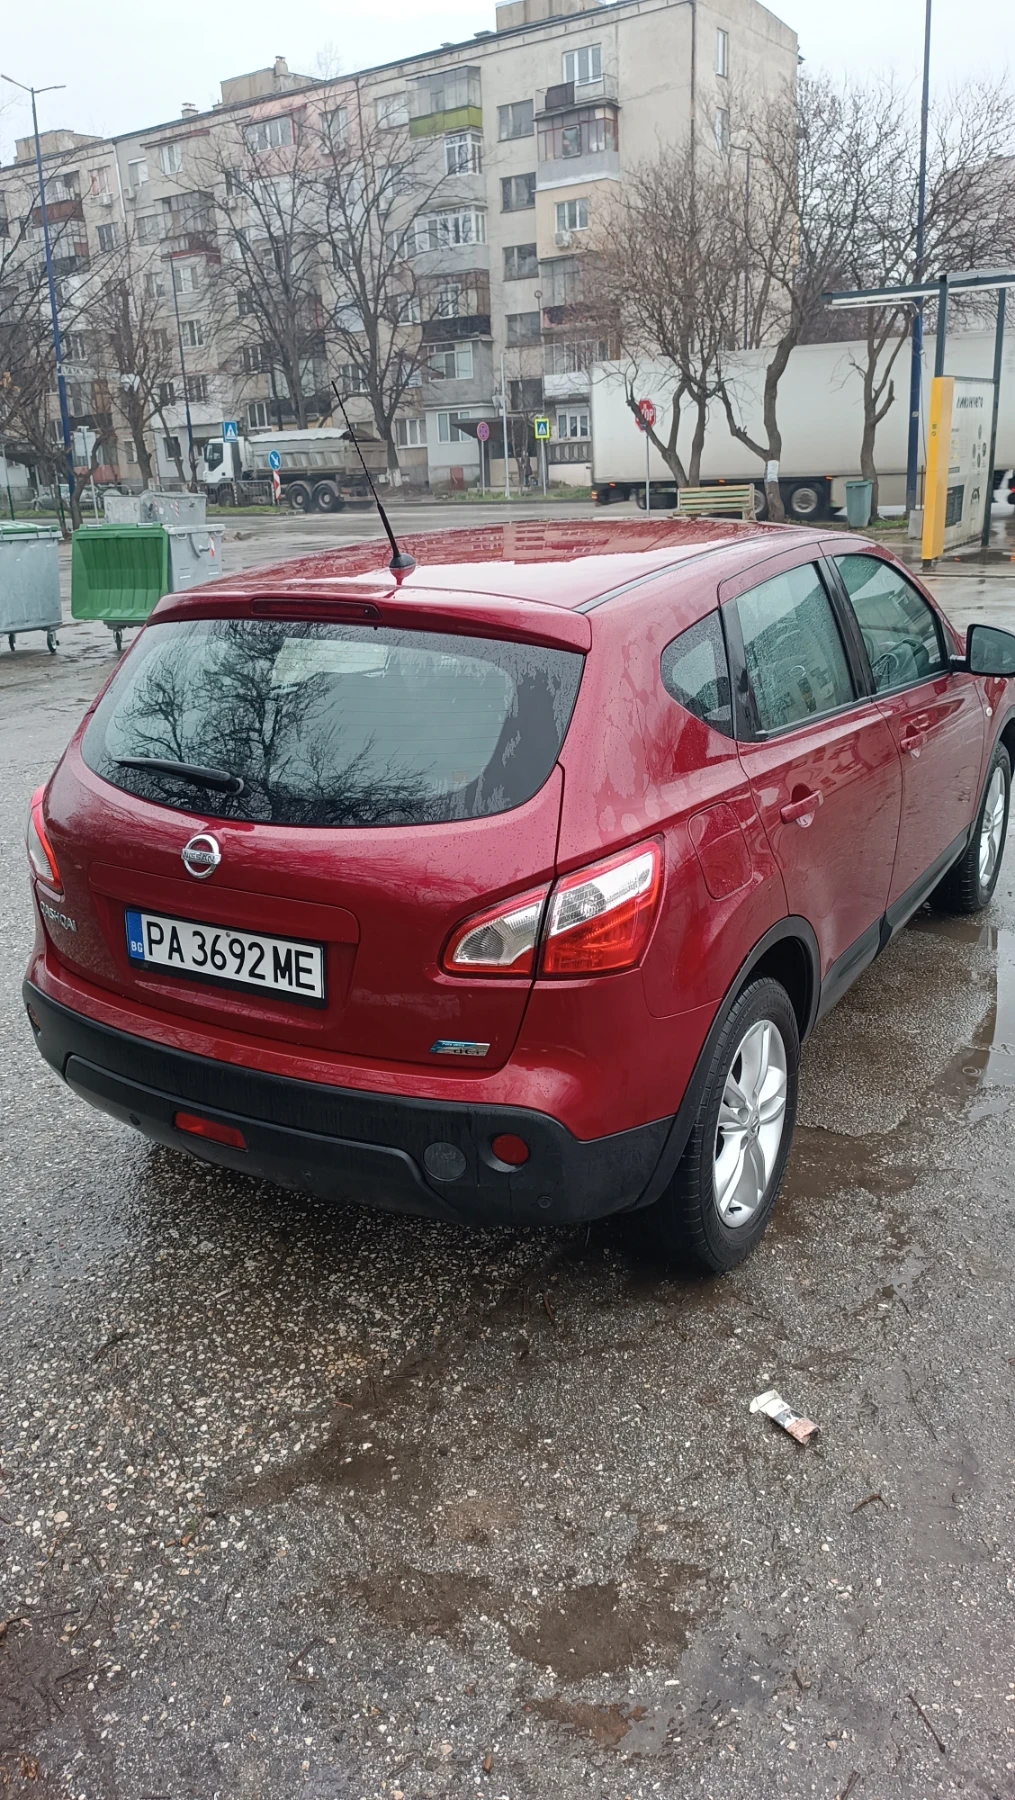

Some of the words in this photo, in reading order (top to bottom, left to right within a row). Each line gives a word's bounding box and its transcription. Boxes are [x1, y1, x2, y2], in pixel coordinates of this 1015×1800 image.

[184, 850, 216, 863] NISSAN
[40, 901, 77, 932] QASHQAI
[130, 941, 143, 953] BG
